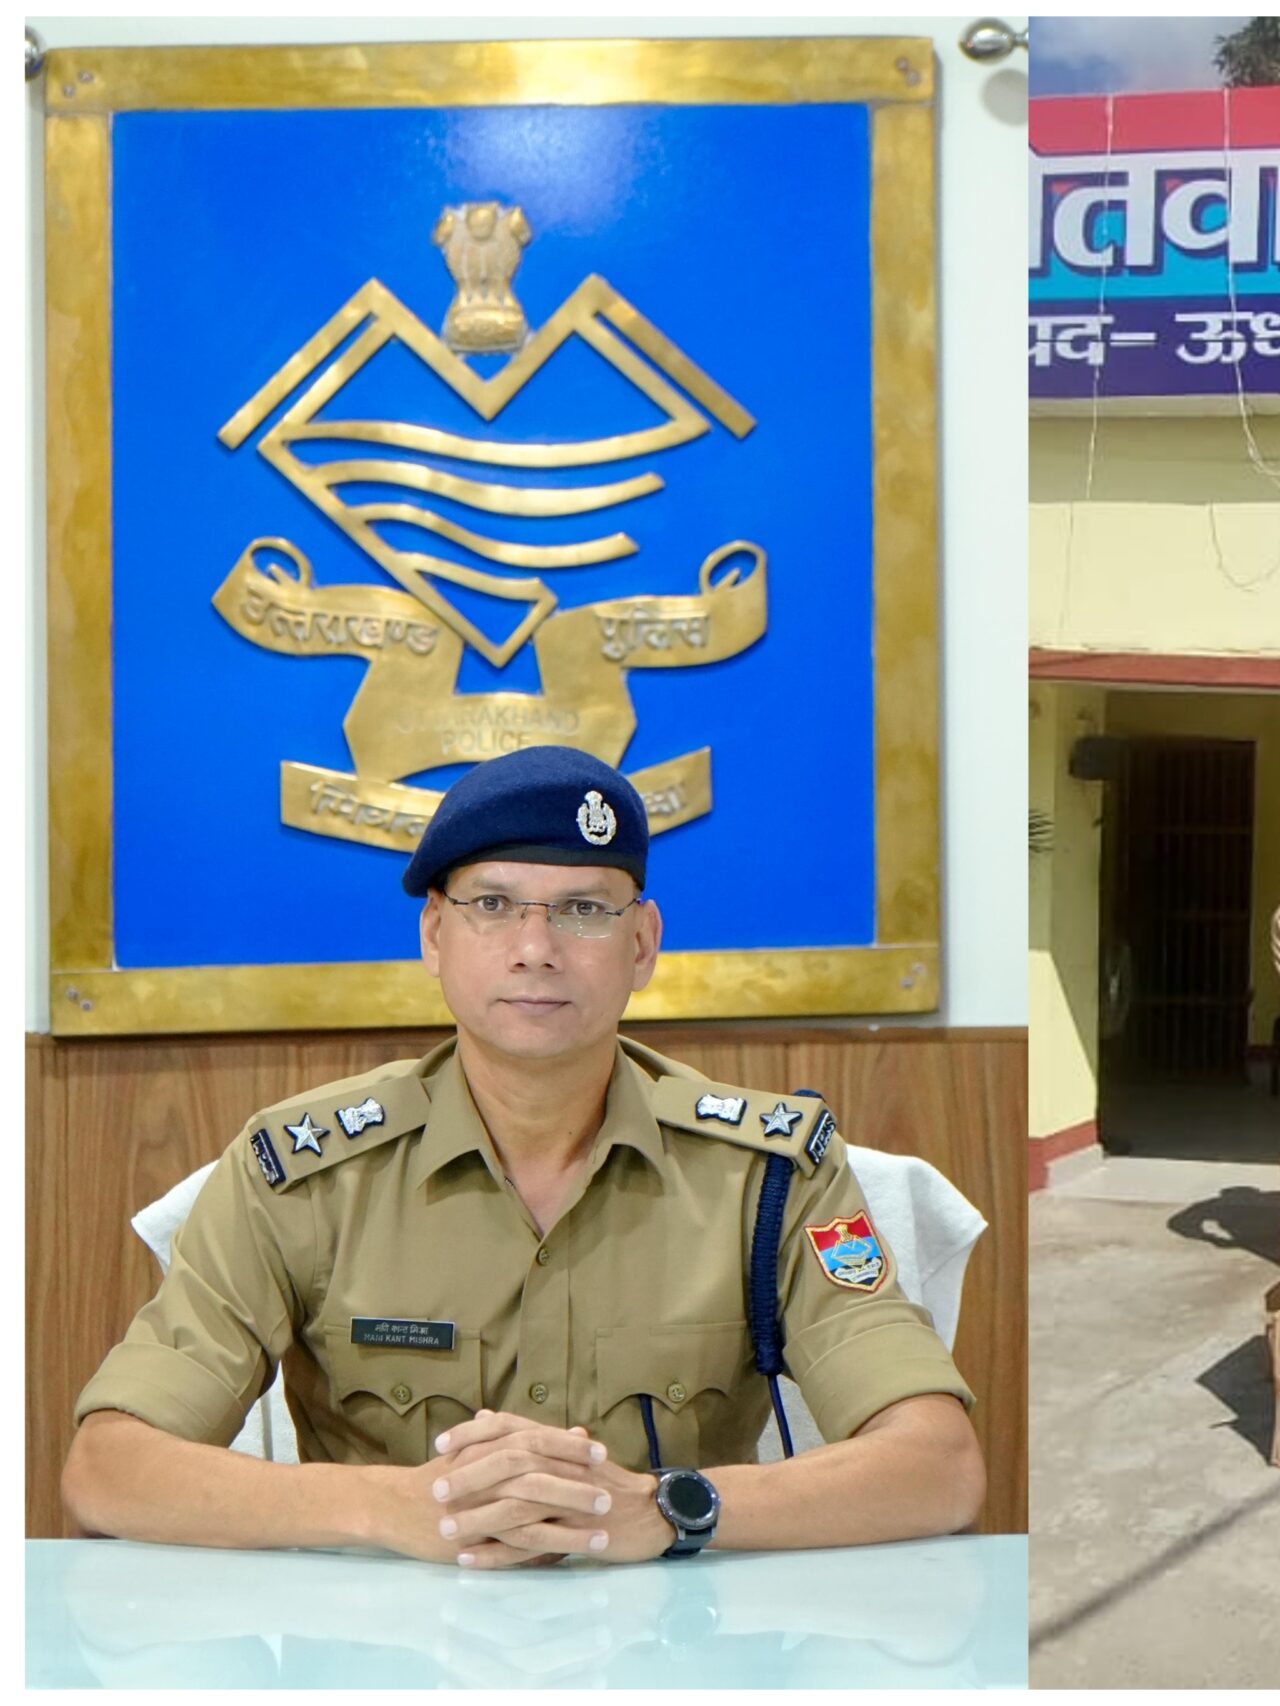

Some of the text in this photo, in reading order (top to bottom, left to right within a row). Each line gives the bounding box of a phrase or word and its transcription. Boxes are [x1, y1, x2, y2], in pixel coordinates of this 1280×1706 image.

[239, 587, 710, 662] उत्तराखण्ड पुलिस
[385, 1334, 406, 1344] KANT
[408, 1336, 440, 1346] MISHRA
